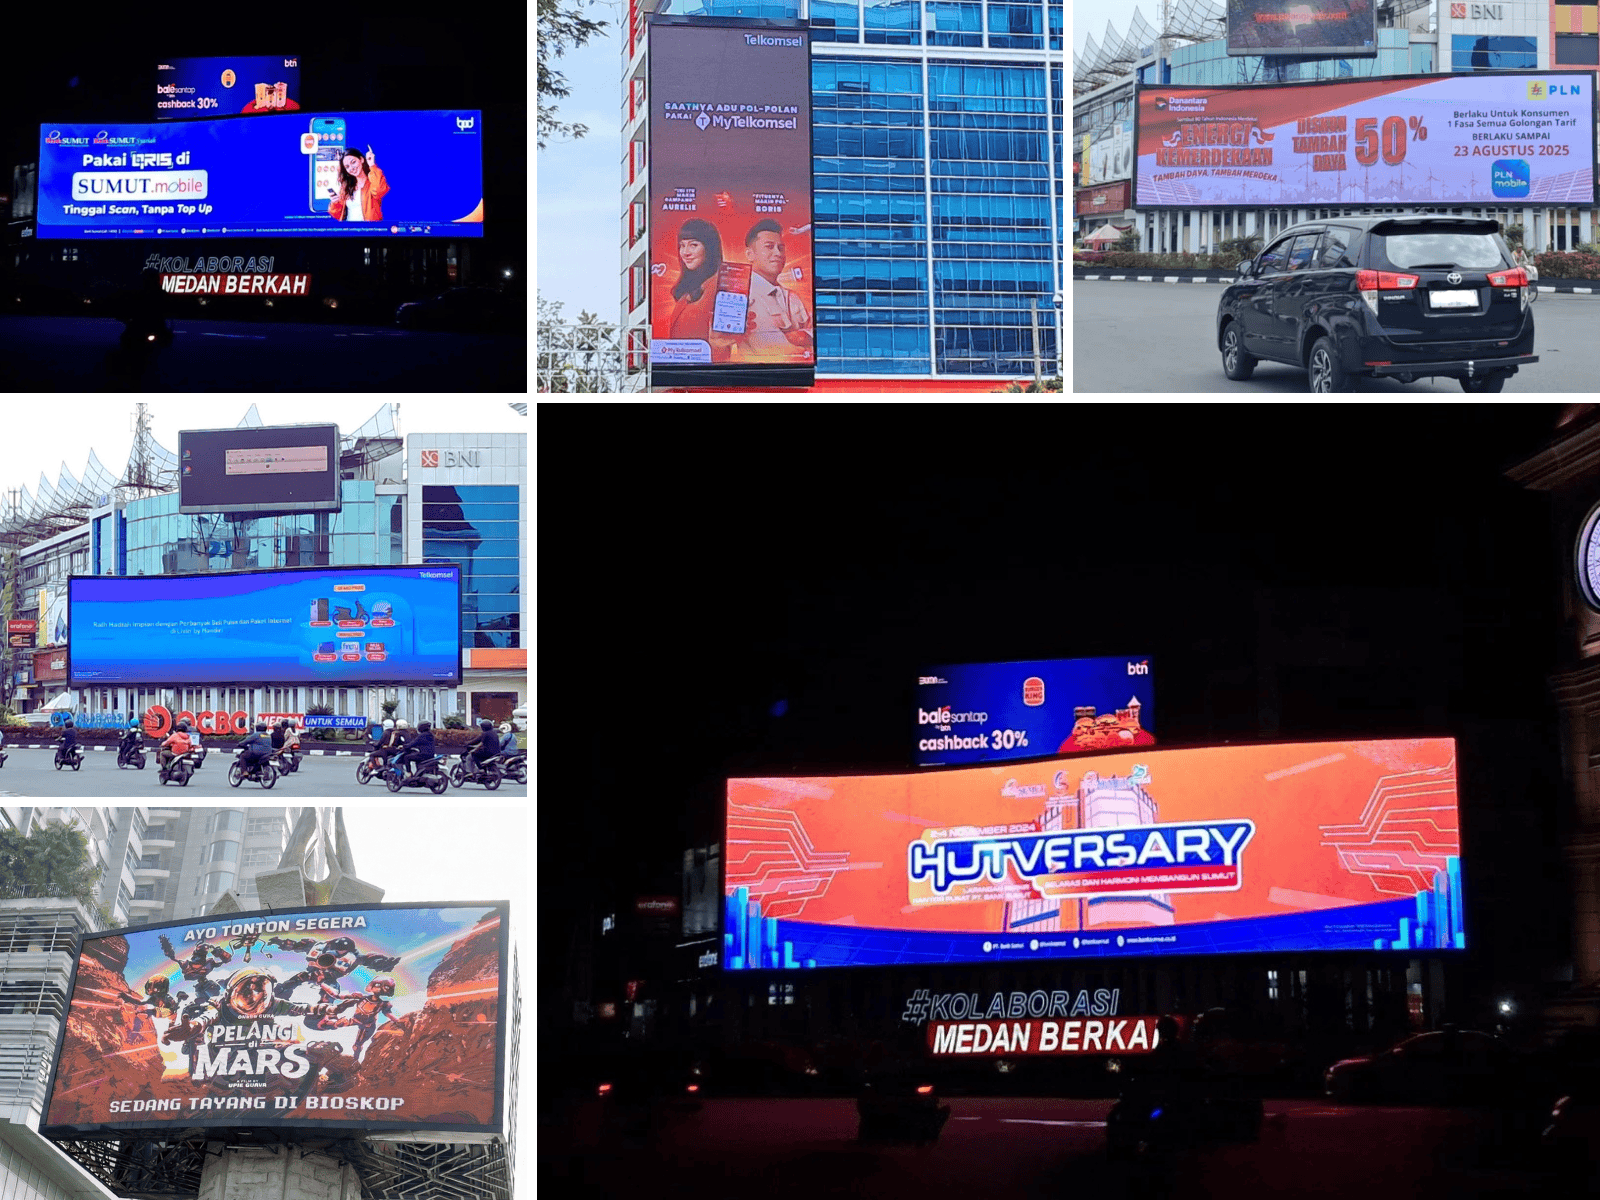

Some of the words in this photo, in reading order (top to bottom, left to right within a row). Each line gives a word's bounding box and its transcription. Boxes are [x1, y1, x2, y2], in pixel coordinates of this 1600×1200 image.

[1471, 5, 1503, 20] BNI
[744, 34, 802, 47] Telkomsel
[284, 58, 297, 67] btn
[157, 99, 195, 108] cashback
[197, 97, 218, 109] 30%
[664, 102, 714, 112] SAATNYA
[716, 104, 738, 112] ADU
[739, 104, 798, 114] POL-POLAN
[1453, 110, 1488, 119] Berlaku
[1490, 110, 1518, 118] Untuk
[1521, 109, 1570, 118] Konsumen
[712, 115, 797, 130] MyTelkomsel
[1297, 116, 1347, 134] DISKON
[1454, 120, 1474, 128] Fasa
[1477, 119, 1507, 127] Semua
[1509, 119, 1552, 129] Golongan
[1555, 118, 1577, 126] Tarif
[1181, 123, 1251, 146] ENERGI
[1355, 115, 1428, 167] 50%
[1472, 133, 1513, 141] BERLAKU
[1515, 132, 1551, 140] SAMPAI
[1292, 134, 1347, 153] TAMBAH
[1454, 145, 1469, 157] 23
[1472, 145, 1535, 156] AGUSTUS
[1538, 145, 1570, 156] 2025
[82, 152, 127, 167] Pakai
[176, 151, 190, 165] di
[1156, 147, 1273, 167] KEMERDEKAAN
[1313, 154, 1347, 172] DAYA
[1153, 171, 1185, 182] TAMBAH
[1211, 169, 1242, 177] TAMBAH
[1243, 170, 1278, 181] MERDEKA
[1495, 179, 1528, 188] mobile
[78, 177, 203, 194] SUMUT.mobile
[63, 204, 106, 216] Tinggal
[108, 204, 139, 215] Scan,
[142, 204, 174, 215] Tanpa
[177, 204, 195, 215] Top
[198, 203, 213, 215] Up
[143, 253, 275, 273] #KOLABORASI
[162, 275, 220, 293] MEDAN
[225, 275, 307, 293] BERKAH
[444, 450, 480, 468] BNI
[419, 571, 453, 579] Telkomsel
[1127, 660, 1148, 676] btn
[305, 718, 333, 726] UNTUK
[335, 718, 364, 726] SEMUA
[919, 731, 988, 751] cashback
[991, 729, 1029, 750] 30%
[949, 826, 1008, 837] NOVEMBER
[1009, 824, 1036, 833] 2024
[914, 826, 1246, 887] HUTVERSARY
[1082, 878, 1100, 886] DAN
[1141, 874, 1200, 883] MEMBANGUN
[1201, 872, 1236, 880] SUMUT
[638, 900, 675, 909] erafone
[184, 927, 217, 942] AYO
[222, 920, 290, 937] TONTON
[295, 916, 367, 931] SEGERA
[902, 988, 1120, 1025] #KOLABORASI
[933, 1022, 1031, 1054] MEDAN
[1039, 1019, 1160, 1051] BERKA
[192, 1043, 310, 1080] MARS
[109, 1097, 182, 1113] SEDANG
[189, 1096, 266, 1111] TAYANG
[274, 1096, 298, 1110] DI
[305, 1096, 405, 1112] BIOSKOP
